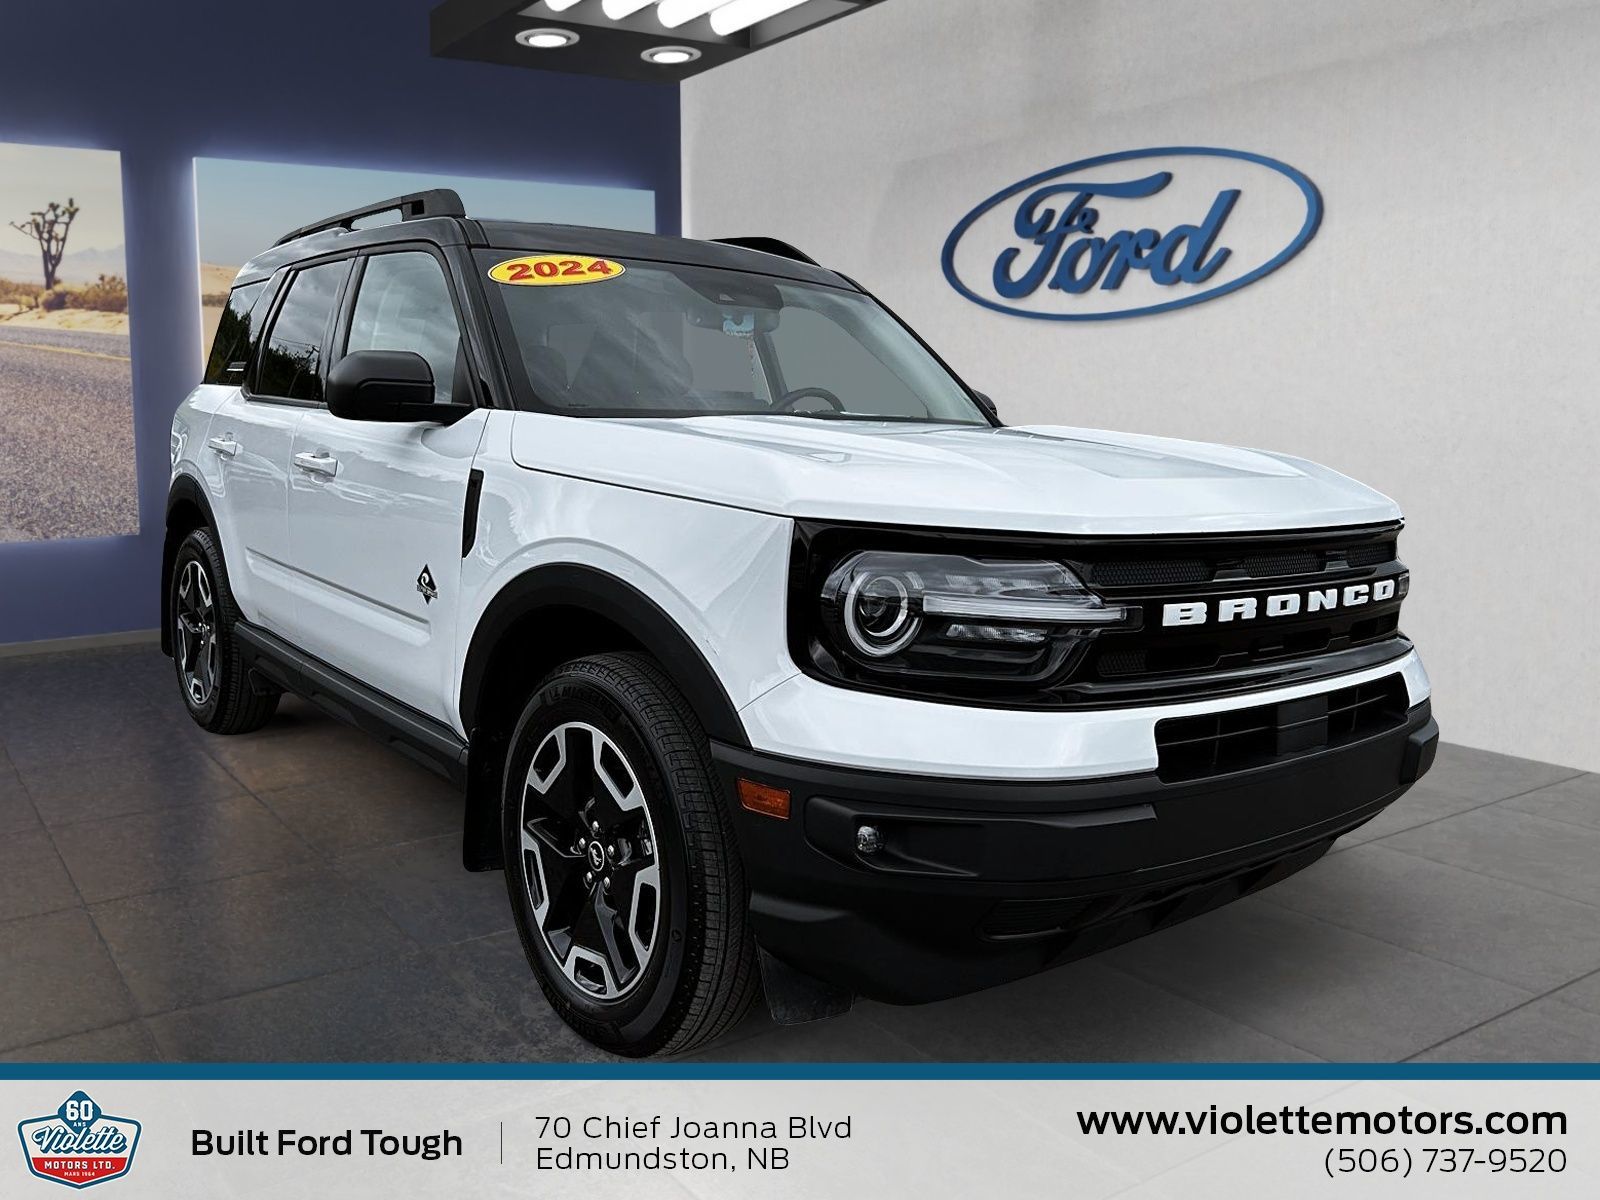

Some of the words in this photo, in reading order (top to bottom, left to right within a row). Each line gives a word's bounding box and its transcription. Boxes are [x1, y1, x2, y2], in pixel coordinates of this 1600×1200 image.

[992, 171, 1241, 299] Ford
[506, 260, 613, 281] 2024
[1162, 579, 1395, 627] BRONCO
